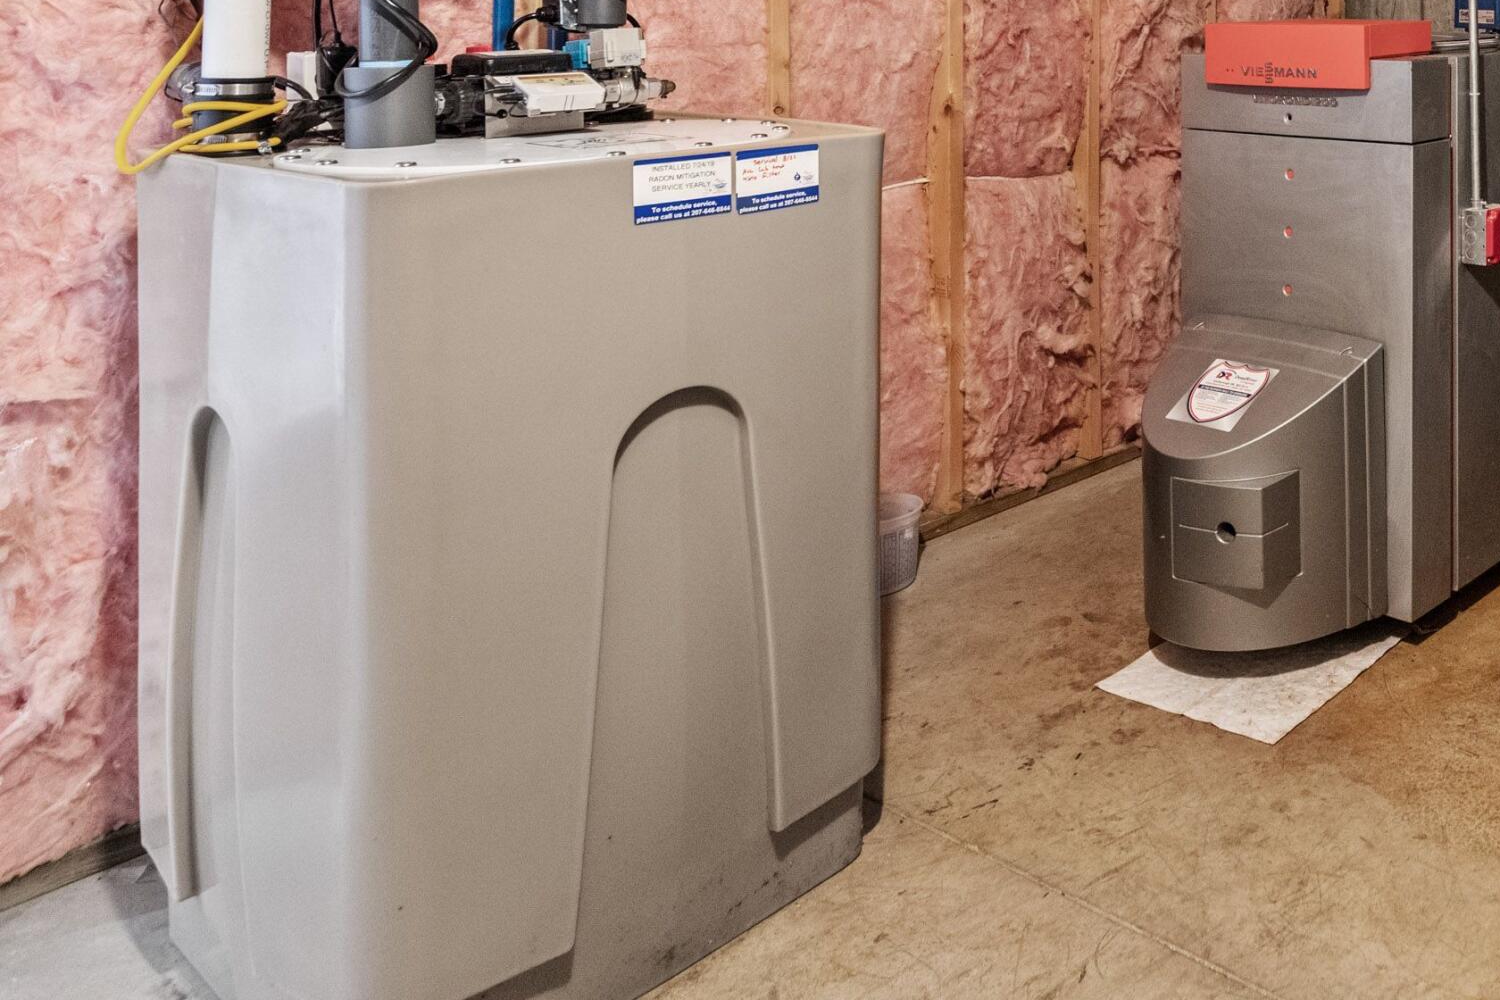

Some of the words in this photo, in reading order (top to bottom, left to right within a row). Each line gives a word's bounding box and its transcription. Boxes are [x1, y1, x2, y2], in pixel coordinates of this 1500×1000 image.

[651, 162, 691, 172] INSTALLED
[649, 174, 675, 183] RADON
[676, 170, 716, 180] MITIGATION
[651, 183, 683, 192] SERVICE
[685, 181, 711, 190] YEARLY
[760, 193, 785, 203] schedule
[786, 191, 807, 199] service,
[662, 202, 692, 212] schedule
[693, 200, 718, 209] service,
[739, 206, 758, 214] please
[636, 214, 659, 224] please
[660, 212, 673, 220] call
